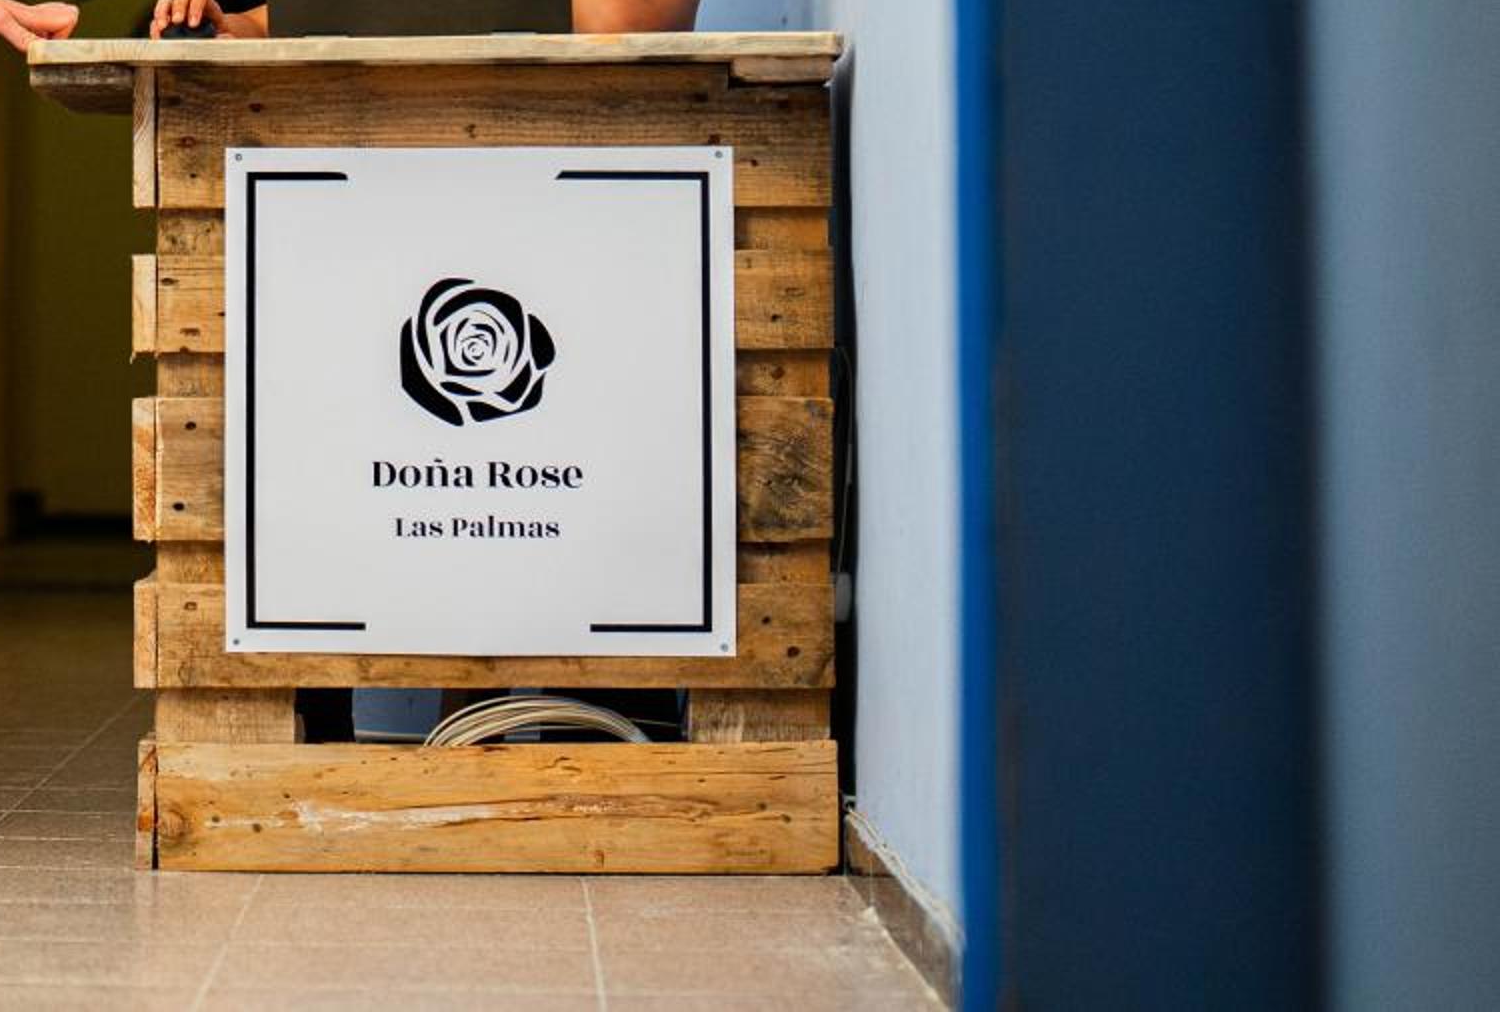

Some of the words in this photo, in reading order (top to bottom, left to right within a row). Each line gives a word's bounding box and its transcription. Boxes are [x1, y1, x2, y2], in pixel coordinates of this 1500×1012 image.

[372, 457, 474, 489] Doña
[487, 461, 584, 489] Rose
[395, 517, 444, 538] Las
[451, 514, 561, 539] Palmas
